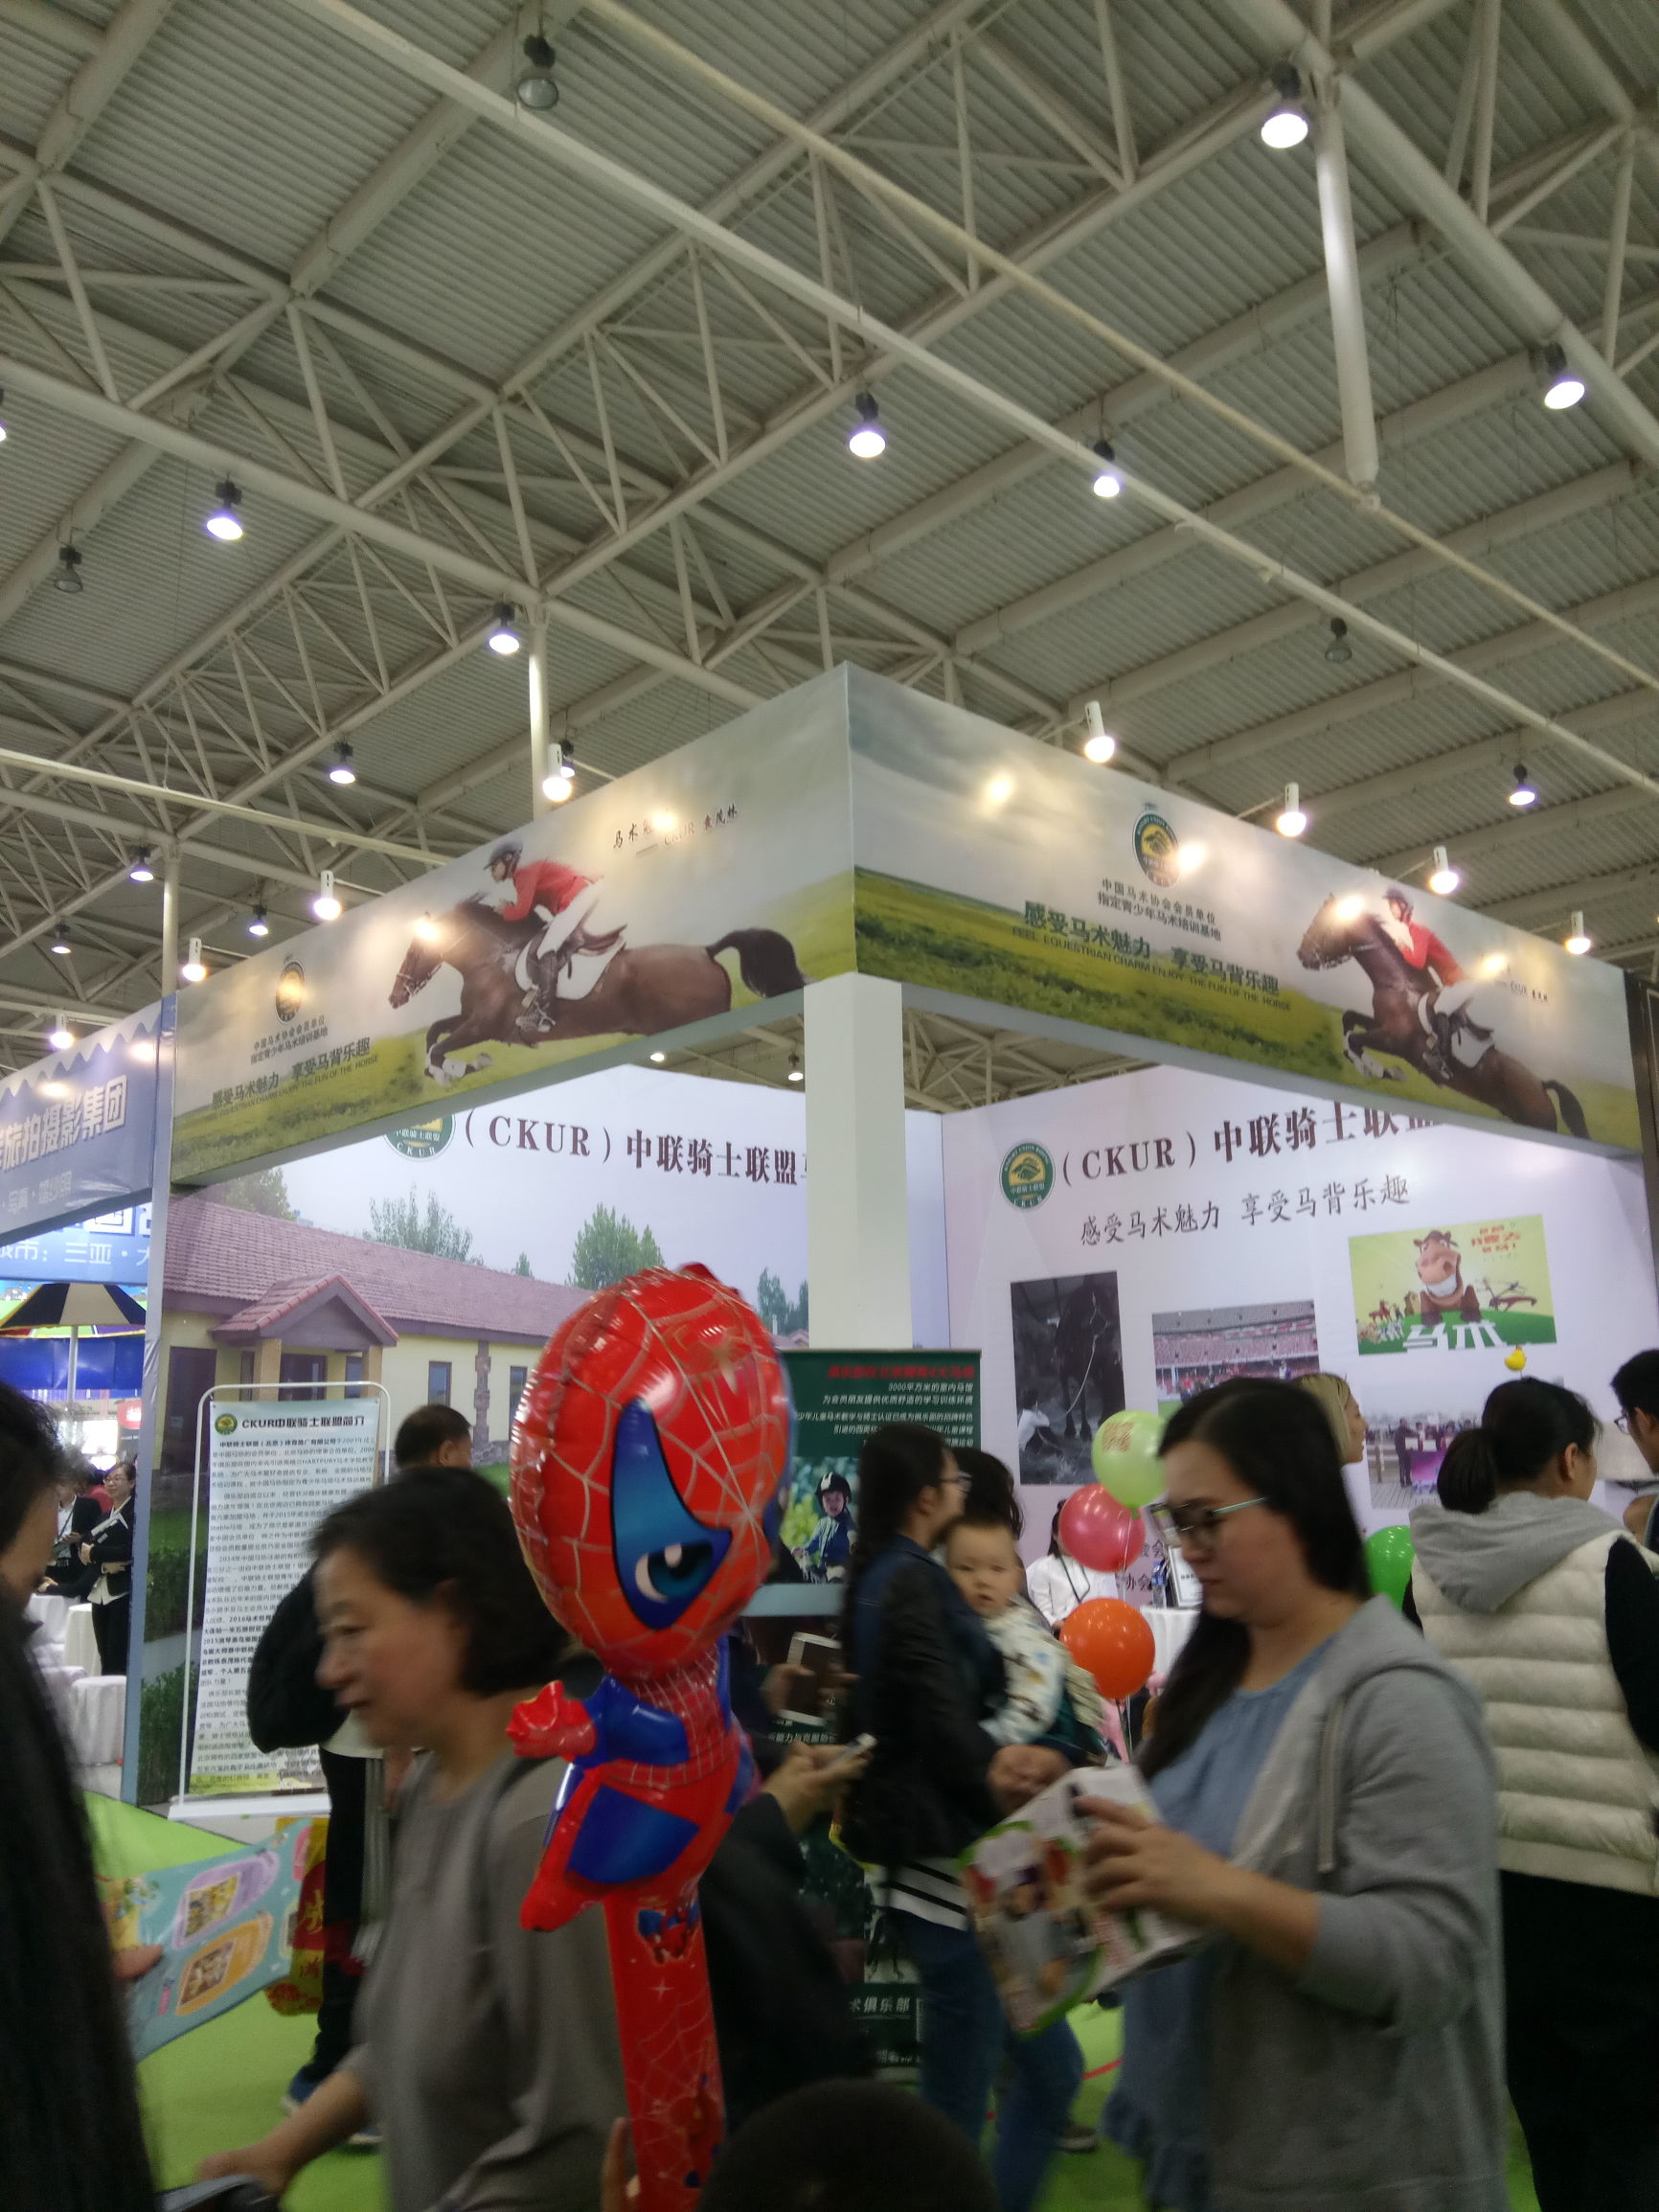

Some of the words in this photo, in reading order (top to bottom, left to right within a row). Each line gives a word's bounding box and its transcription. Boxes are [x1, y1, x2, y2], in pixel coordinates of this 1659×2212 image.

[1098, 891, 1222, 943] 指定青少年马术培训基地
[1102, 877, 1216, 925] 中国马术协会会员单位
[1024, 900, 1149, 959] 感受马术魅力
[1170, 946, 1280, 997] 享受马背乐趣
[1044, 935, 1111, 963] EQUESTRIAN
[1114, 956, 1149, 973] CHARM
[212, 1072, 280, 1110] 感受马术魅力
[291, 1037, 371, 1082] 享受马背乐趣
[0, 1075, 126, 1172] 旅拍摄影集团
[397, 1142, 435, 1157] CKUR
[1079, 1200, 1220, 1246] 感受马术魅力
[1240, 1174, 1411, 1227] 享受马背乐趣
